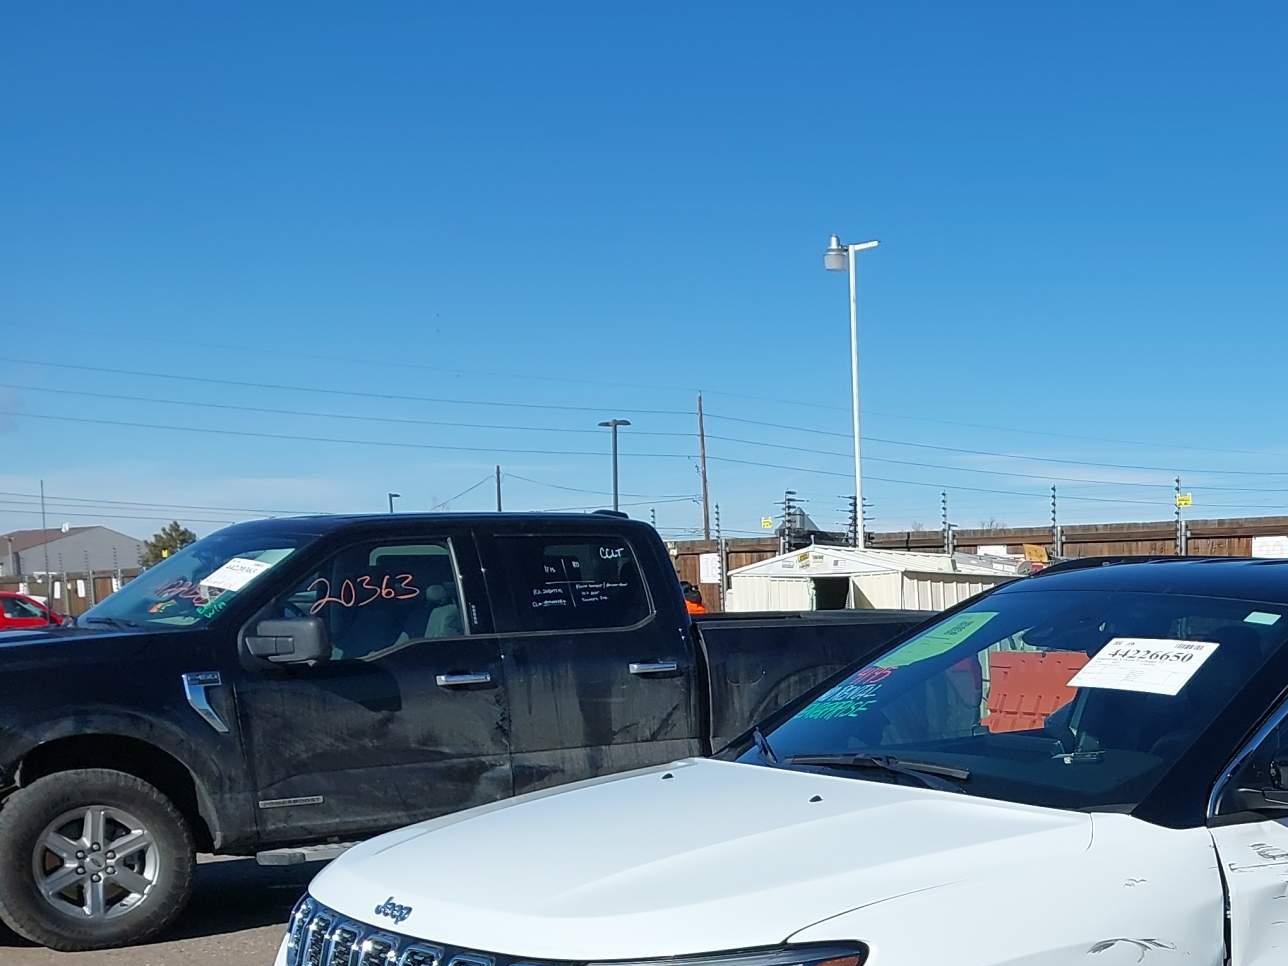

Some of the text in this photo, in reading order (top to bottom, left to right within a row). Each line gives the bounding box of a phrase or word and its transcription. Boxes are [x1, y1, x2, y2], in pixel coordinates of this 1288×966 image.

[307, 574, 420, 615] 20363
[1108, 648, 1194, 663] 44226650
[375, 896, 413, 925] Jeep
